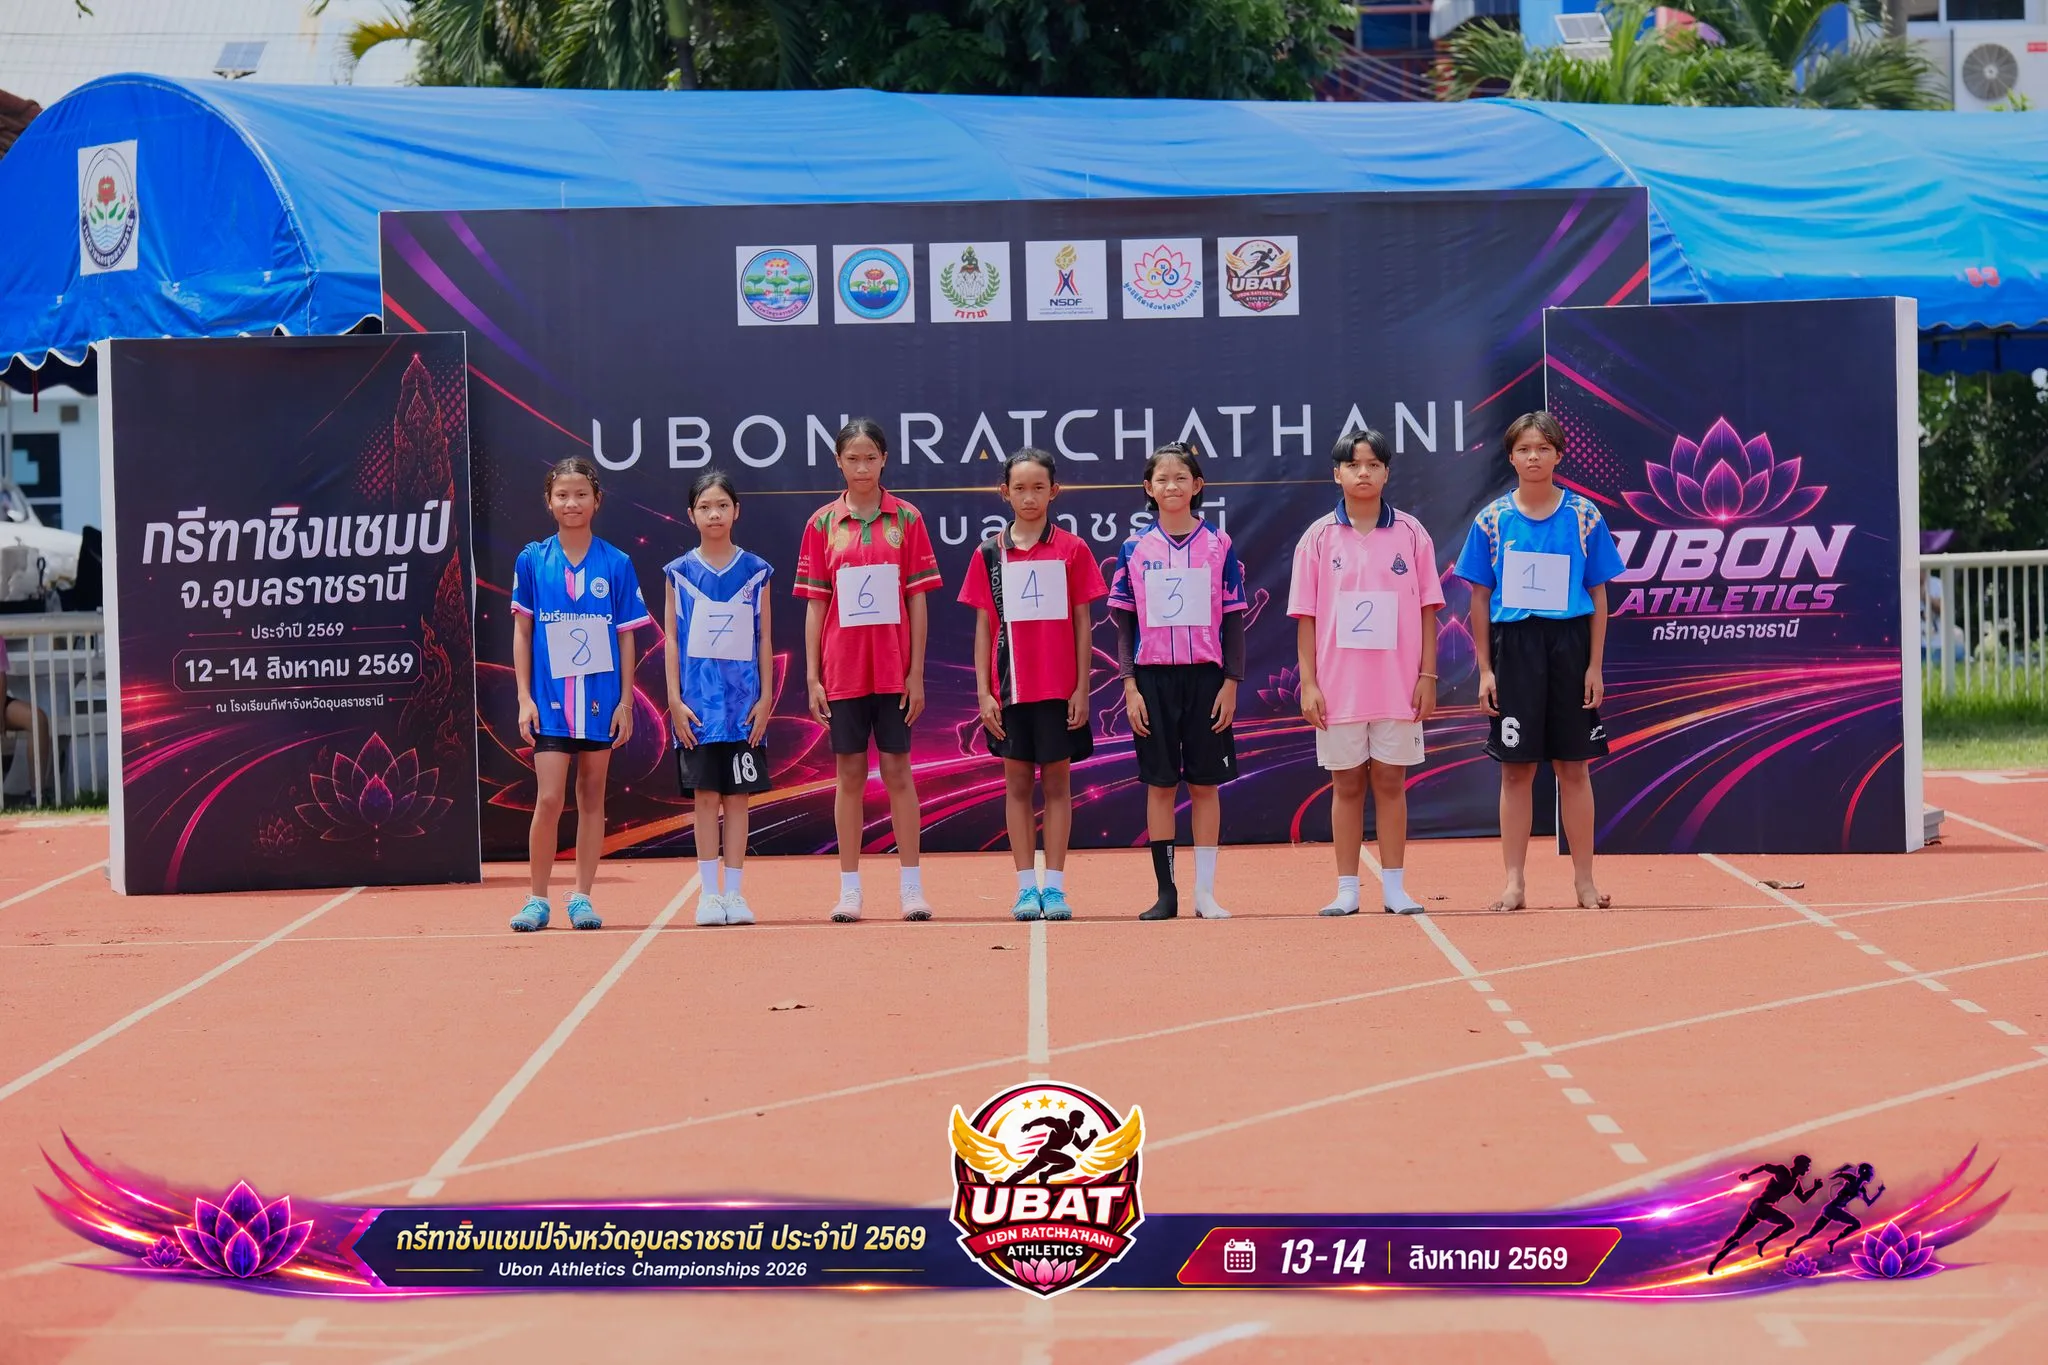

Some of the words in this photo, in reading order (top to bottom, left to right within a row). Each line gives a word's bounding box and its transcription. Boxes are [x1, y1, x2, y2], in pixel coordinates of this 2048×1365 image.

[1231, 276, 1287, 292] UBAT
[1050, 298, 1083, 307] NSDF
[592, 414, 849, 471] UBON
[900, 399, 1464, 465] RATCHATHANI
[142, 499, 452, 565] กรีฑาชิงแชมป์
[1611, 524, 1857, 583] UBON
[180, 562, 408, 619] จ.อุบลราชธานี
[857, 574, 875, 609] 6
[1020, 569, 1044, 608] 4
[1522, 562, 1546, 592] 1
[1162, 577, 1184, 619] 3
[1609, 584, 1848, 617] ATHLETICS
[251, 623, 302, 639] ประจำปี
[307, 622, 344, 637] 2569
[708, 614, 734, 647] 7
[1351, 600, 1374, 633] 2
[1652, 617, 1800, 646] กรีฑาอุบลราชธานี
[569, 628, 592, 667] 8
[267, 655, 350, 680] สิงหาคม
[358, 652, 414, 675] 2569
[1501, 716, 1521, 748] 6
[732, 751, 758, 785] 18
